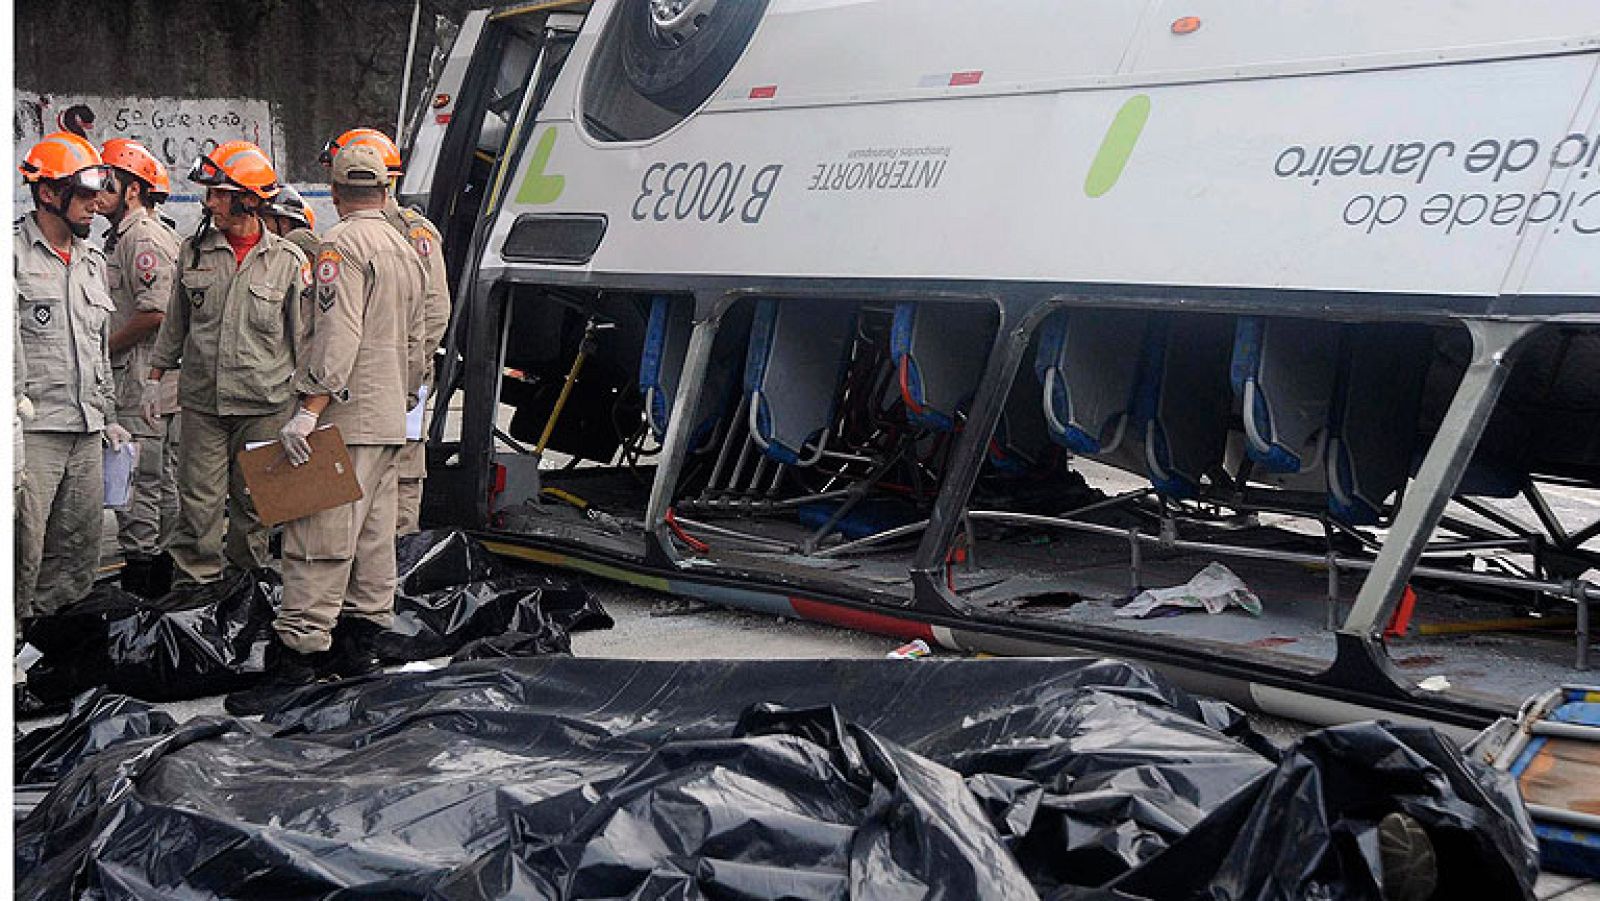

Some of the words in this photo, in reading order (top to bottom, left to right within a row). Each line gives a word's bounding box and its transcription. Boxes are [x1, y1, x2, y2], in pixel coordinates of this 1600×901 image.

[807, 159, 949, 191] INTERNORTE
[1274, 141, 1455, 186] Janeiro
[1464, 138, 1540, 182] de
[1550, 133, 1600, 180] io
[631, 161, 784, 224] B10033
[1343, 193, 1407, 235] do
[1420, 190, 1600, 235] Cidade
